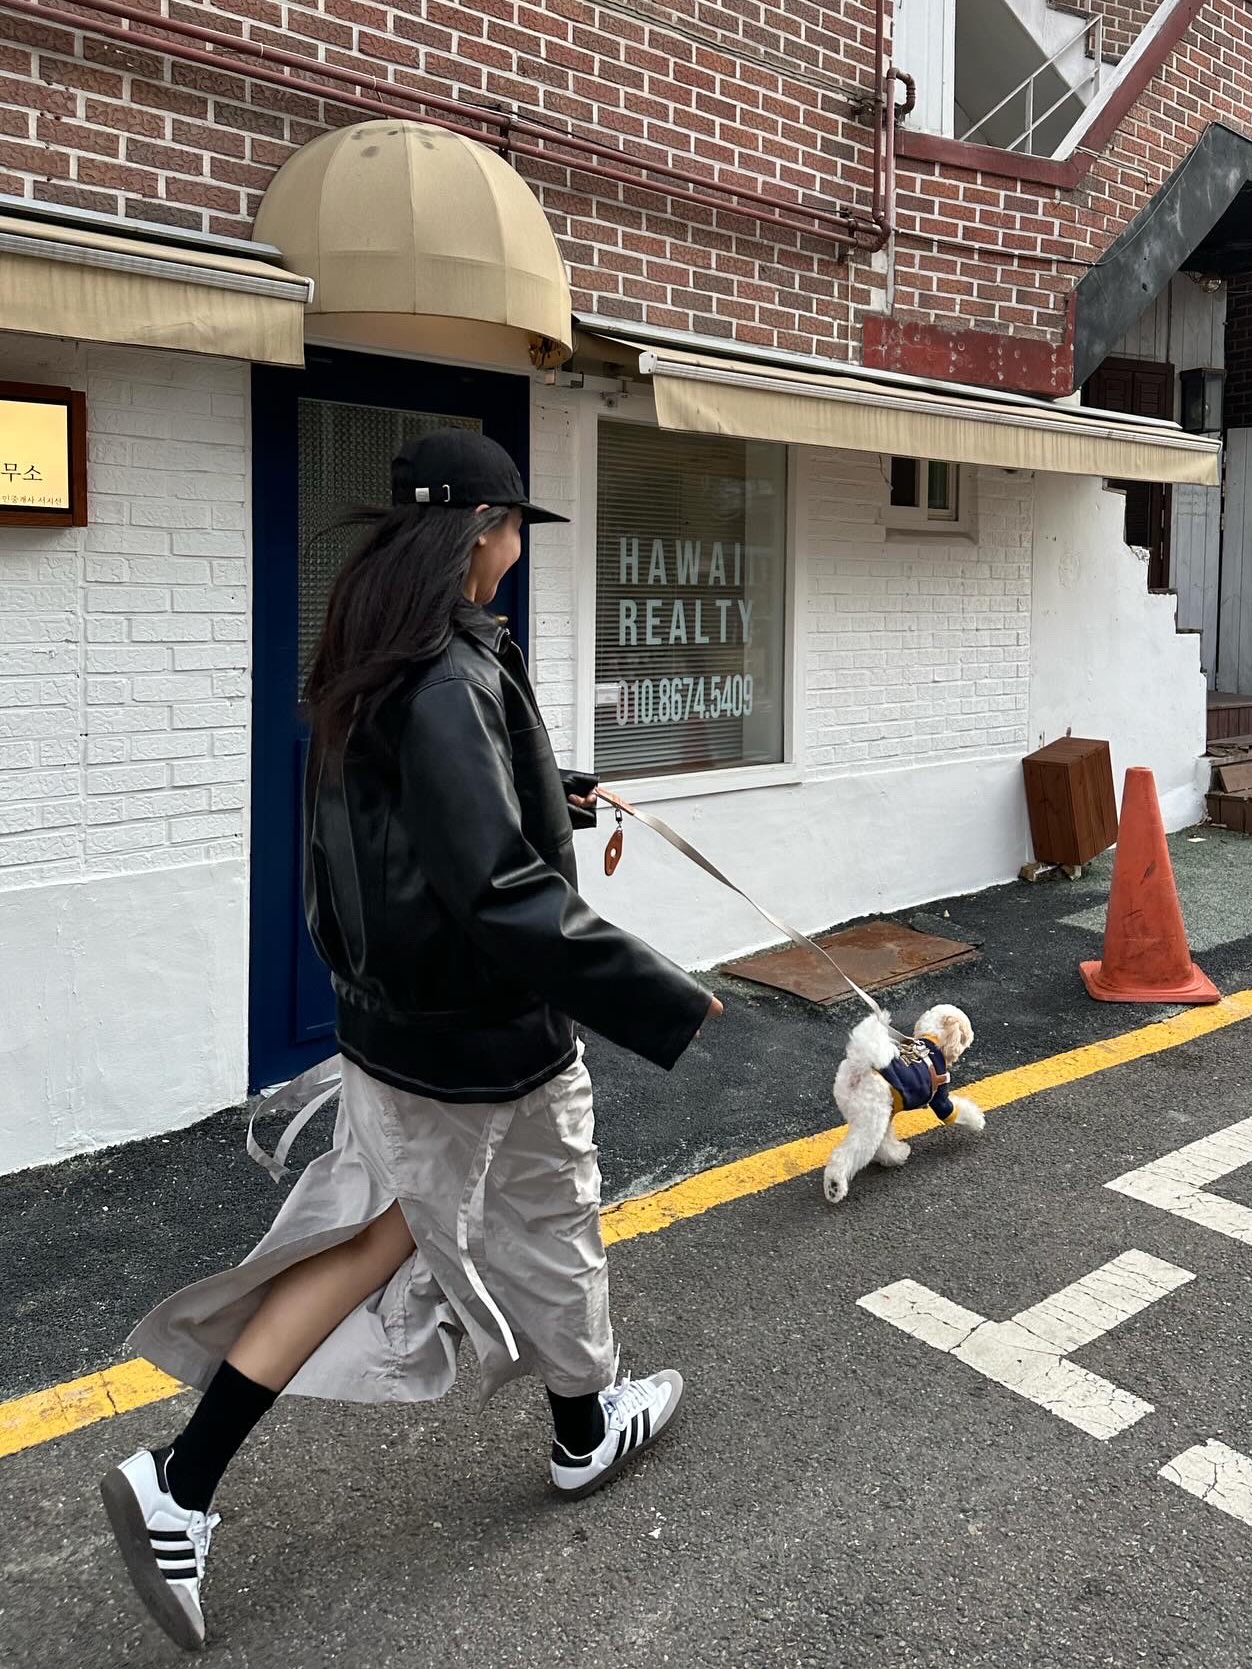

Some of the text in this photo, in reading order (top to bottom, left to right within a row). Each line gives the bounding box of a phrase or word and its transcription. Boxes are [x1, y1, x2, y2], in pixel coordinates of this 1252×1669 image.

[1, 463, 43, 482] 무소
[619, 599, 753, 646] REALTY
[616, 674, 754, 726] 010.8674.5409
